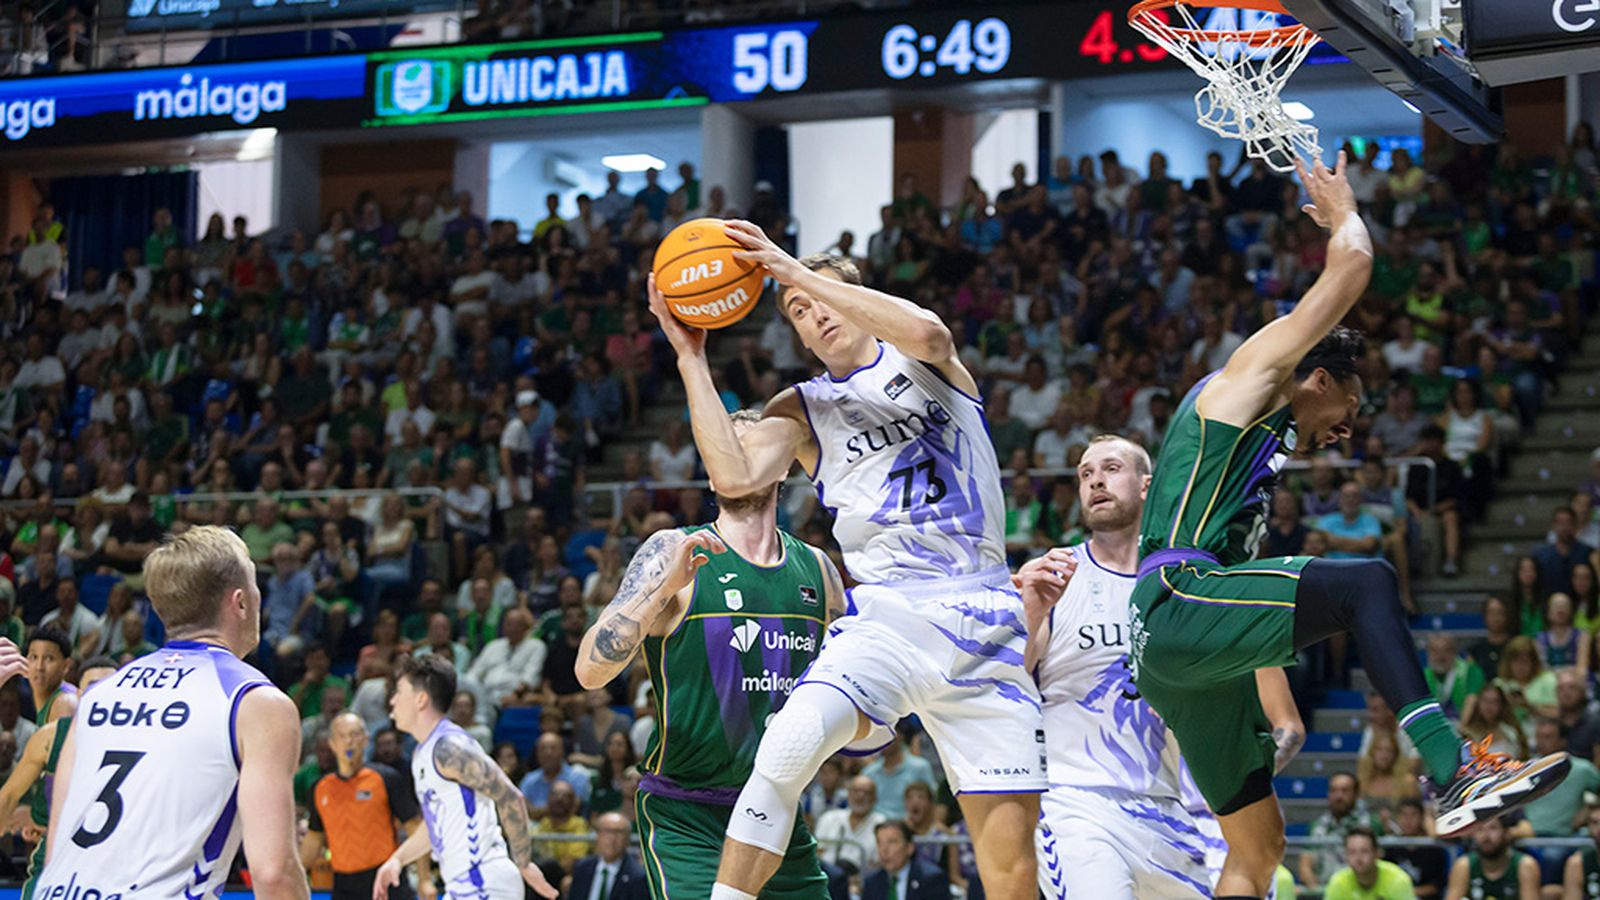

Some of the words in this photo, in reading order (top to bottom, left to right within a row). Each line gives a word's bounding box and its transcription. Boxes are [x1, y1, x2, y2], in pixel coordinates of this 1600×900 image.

[734, 30, 808, 93] 50
[882, 19, 1010, 79] 6:49
[463, 52, 629, 106] UNICAJA
[0, 97, 55, 141] ga
[888, 457, 947, 513] 73
[1078, 623, 1131, 650] su
[117, 667, 194, 688] FREY
[88, 702, 156, 726] bbk
[979, 768, 1030, 776] NISSAN
[72, 751, 146, 849] 3
